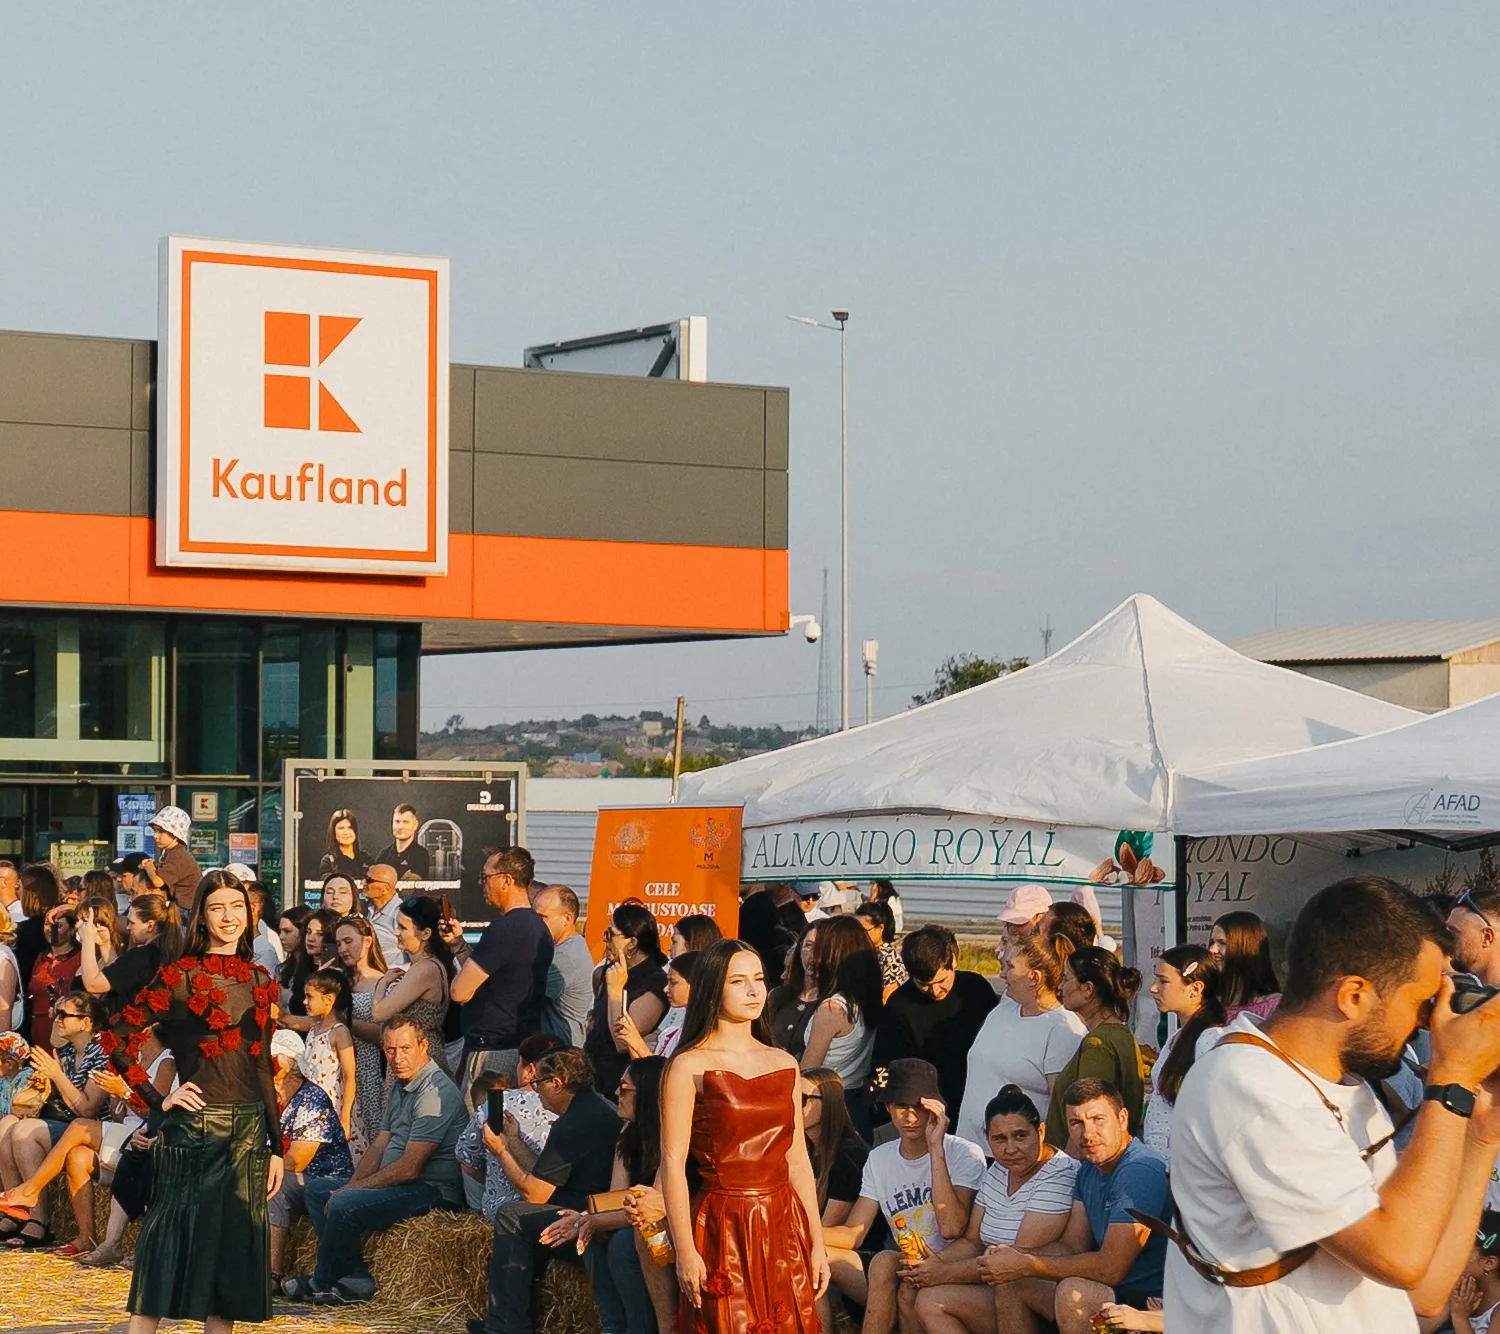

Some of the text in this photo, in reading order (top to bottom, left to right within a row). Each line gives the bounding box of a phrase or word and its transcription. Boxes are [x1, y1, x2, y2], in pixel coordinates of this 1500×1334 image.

[212, 457, 408, 507] Kaufland
[1432, 794, 1481, 812] AFAD
[751, 828, 1065, 868] ALMONDO ROYAL
[645, 882, 681, 896] CELE
